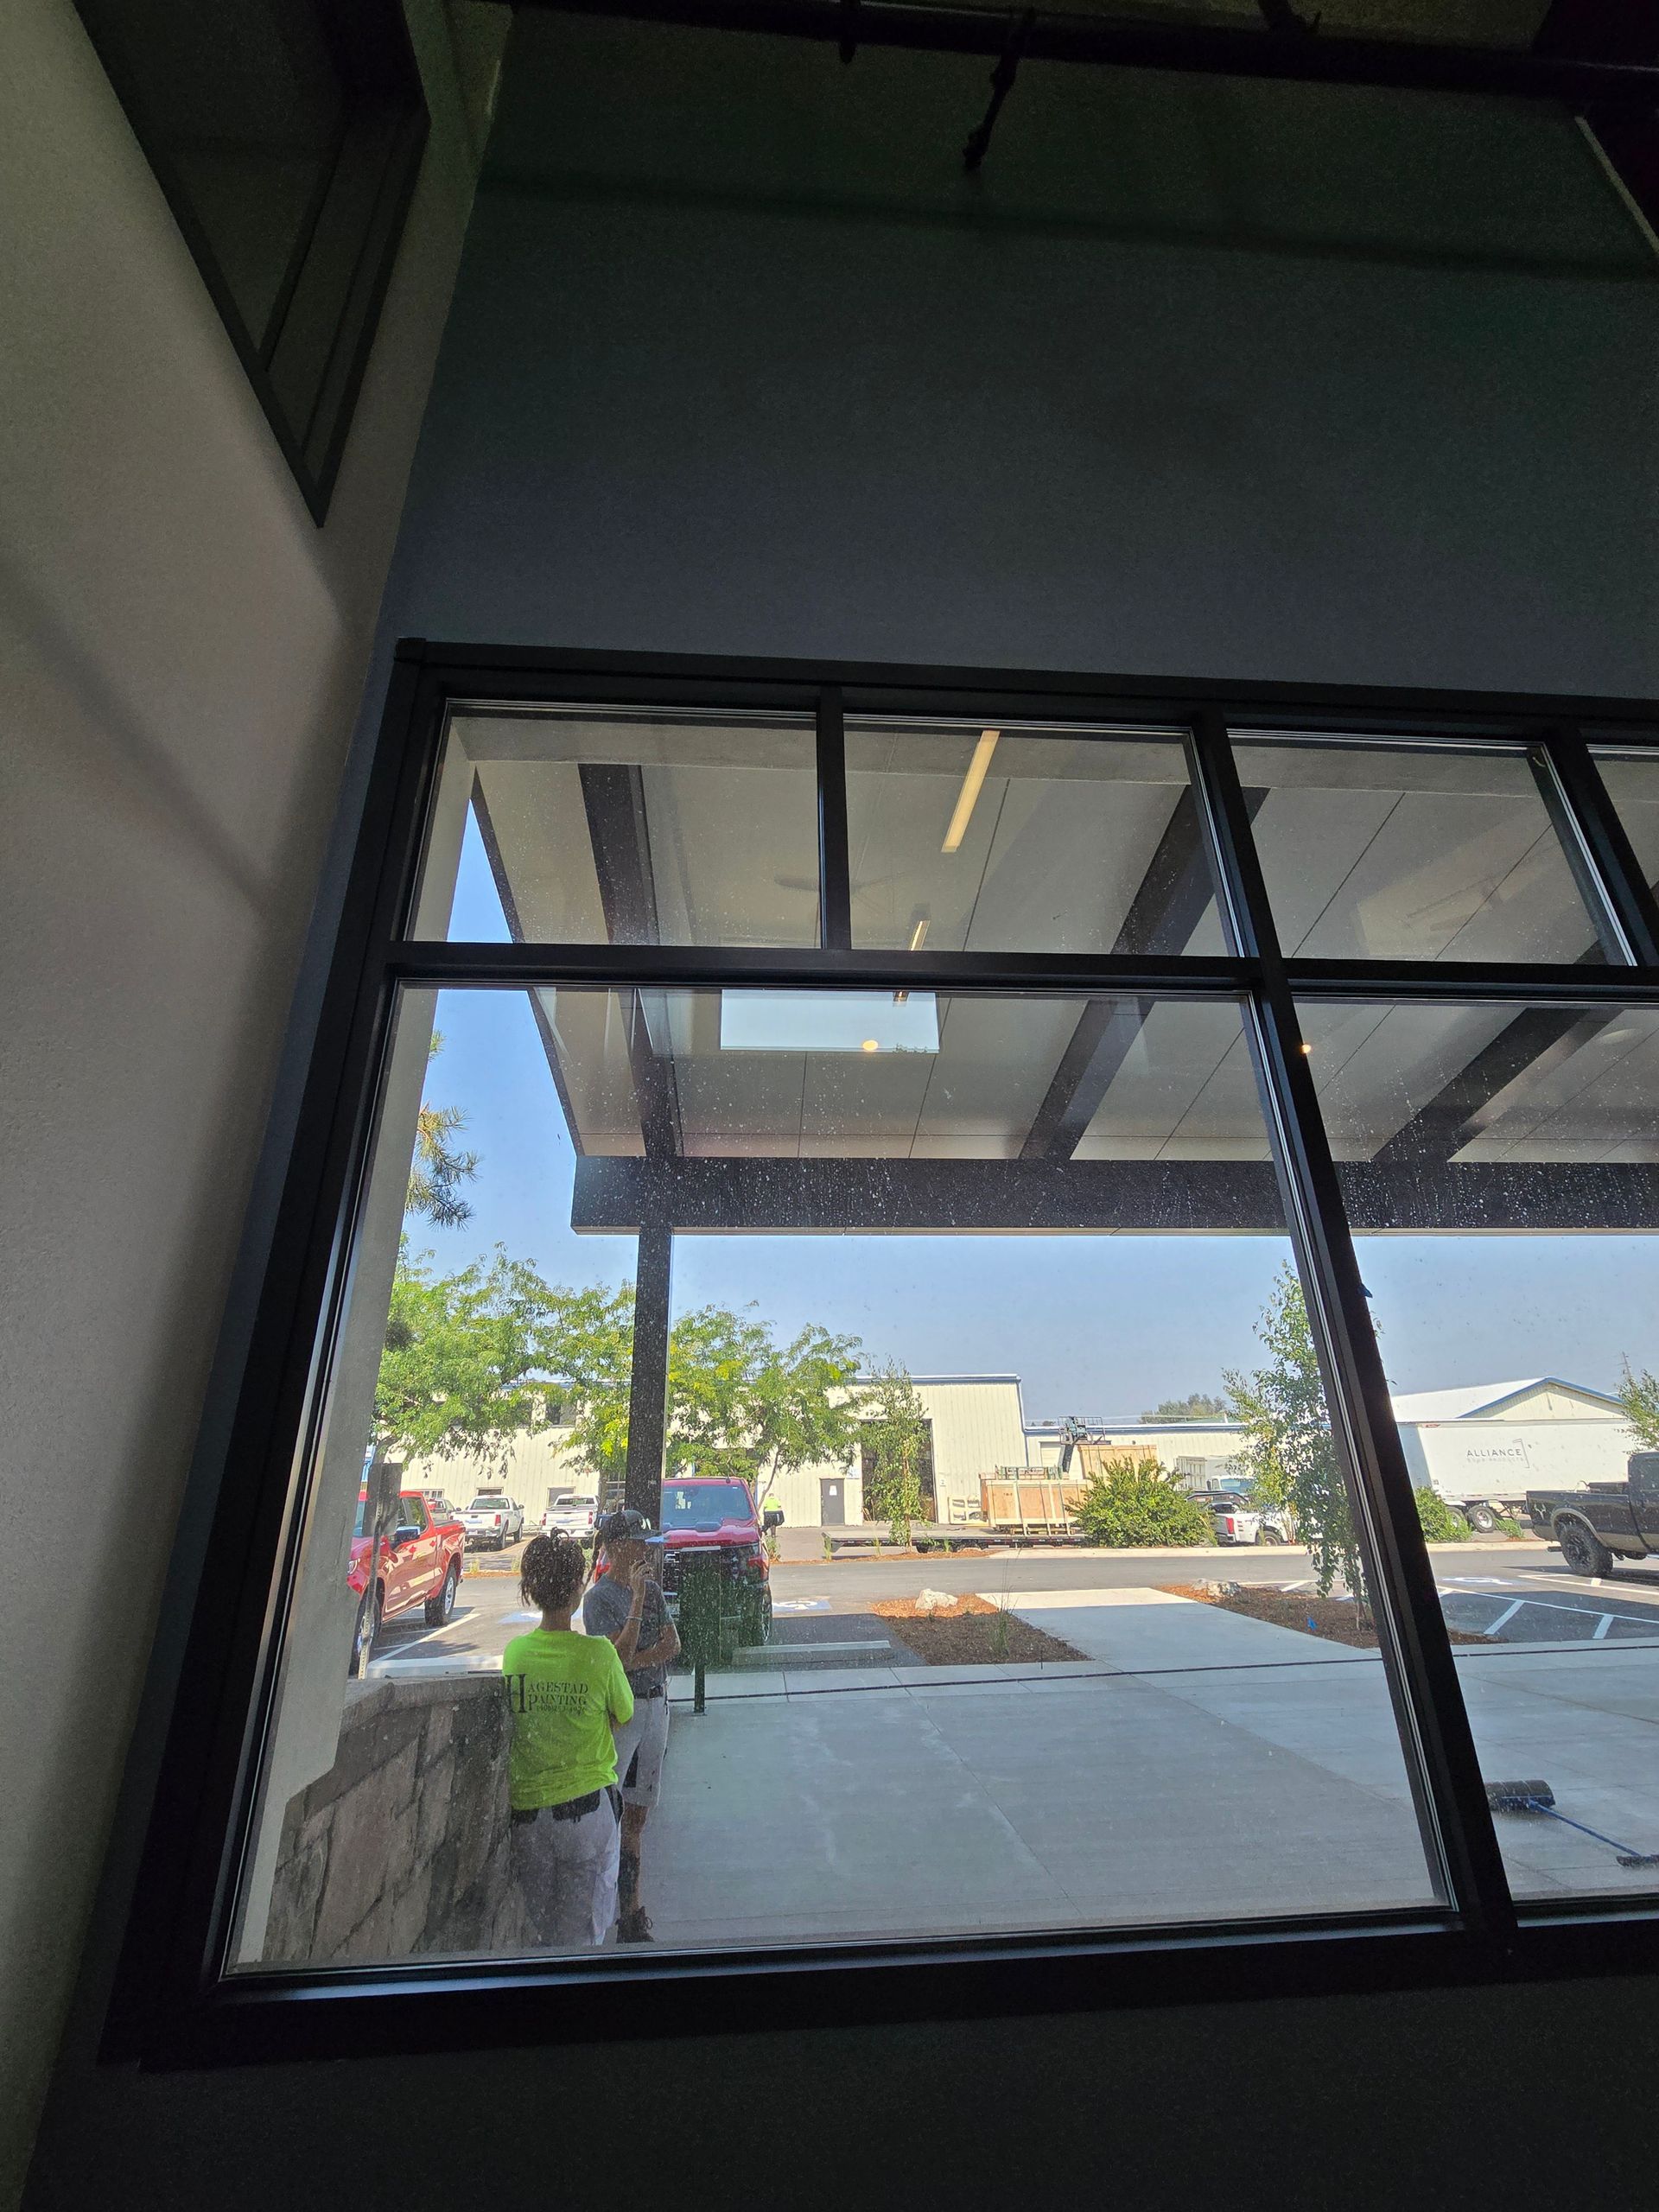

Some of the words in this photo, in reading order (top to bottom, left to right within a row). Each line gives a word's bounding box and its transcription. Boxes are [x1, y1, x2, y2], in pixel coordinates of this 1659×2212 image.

[1466, 1448, 1522, 1458] ALLIANCE
[505, 1673, 588, 1713] HAGESTAD
[528, 1694, 587, 1711] PAINTING
